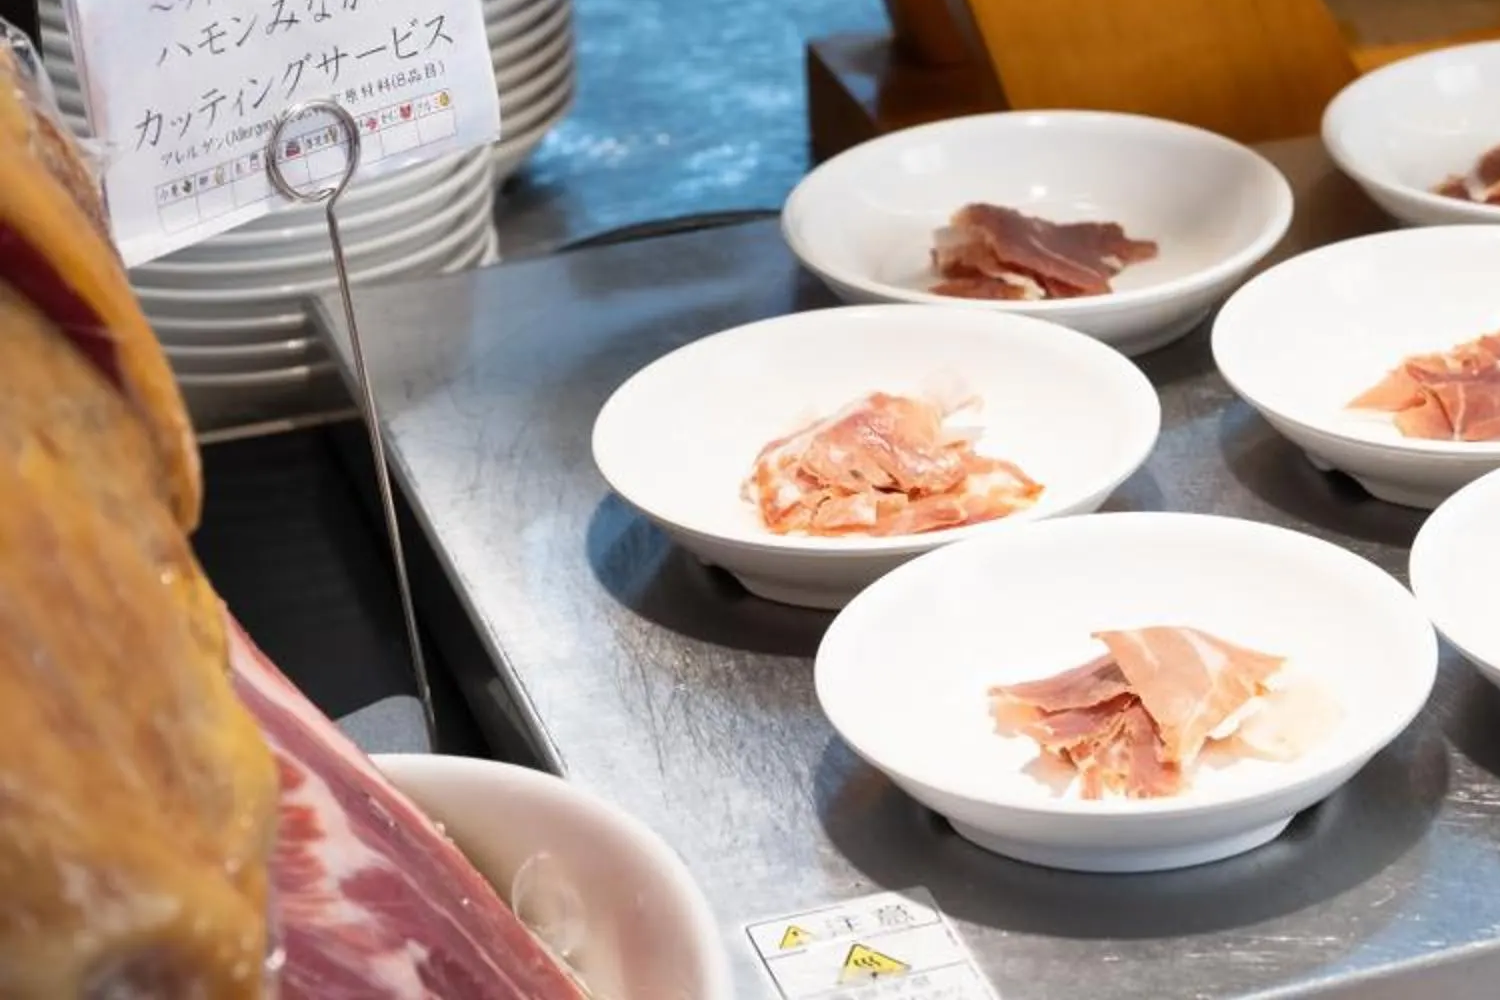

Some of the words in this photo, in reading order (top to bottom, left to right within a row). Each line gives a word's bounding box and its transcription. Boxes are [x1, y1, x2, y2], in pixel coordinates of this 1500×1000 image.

[134, 14, 454, 151] カッティングサービス
